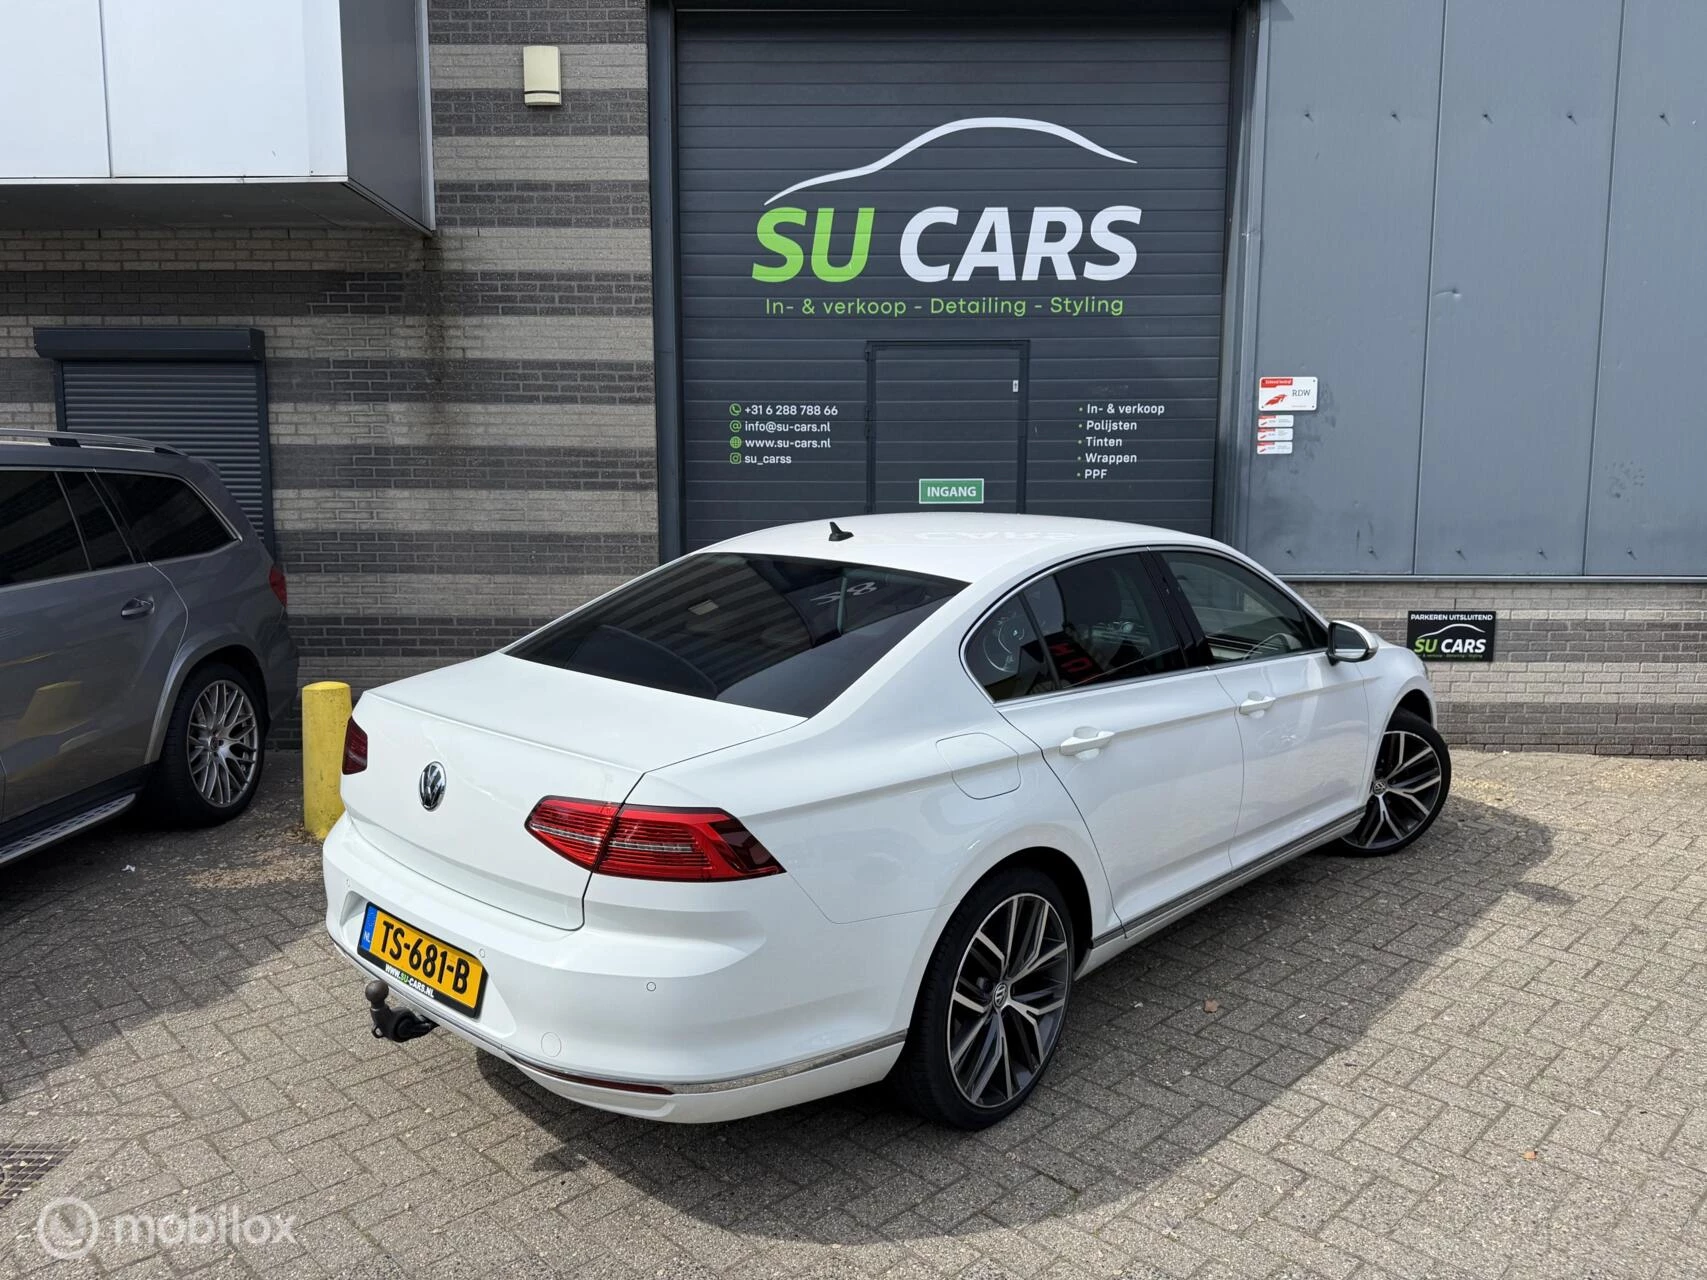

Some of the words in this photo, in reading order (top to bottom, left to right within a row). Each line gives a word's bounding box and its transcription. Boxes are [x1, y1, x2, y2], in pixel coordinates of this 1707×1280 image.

[751, 206, 875, 283] SU
[899, 205, 1142, 283] CARS
[766, 298, 794, 314] In-
[801, 298, 816, 315] &
[822, 298, 907, 318] verkoop
[930, 297, 1027, 318] Detailing
[1050, 296, 1124, 316] Styling
[1292, 389, 1311, 397] RDW
[744, 405, 763, 415] +31
[766, 405, 773, 415] 6
[776, 405, 797, 416] 288
[800, 405, 821, 416] 788
[824, 405, 839, 416] 66
[1087, 403, 1103, 414] In-
[1106, 403, 1115, 414] &
[1119, 403, 1165, 416] verkoop
[745, 421, 831, 433] info@su-cars.nl
[1086, 420, 1138, 432] Polijsten
[745, 438, 832, 448] www.su-cars.nl
[1085, 436, 1123, 447] Tinten
[744, 455, 792, 465] su_carss
[1085, 452, 1138, 465] Wrappen
[1084, 469, 1108, 479] PPF
[927, 486, 977, 497] INGANG
[1414, 639, 1438, 653] SU
[1441, 638, 1486, 653] CARS
[381, 920, 470, 994] TS-681-B
